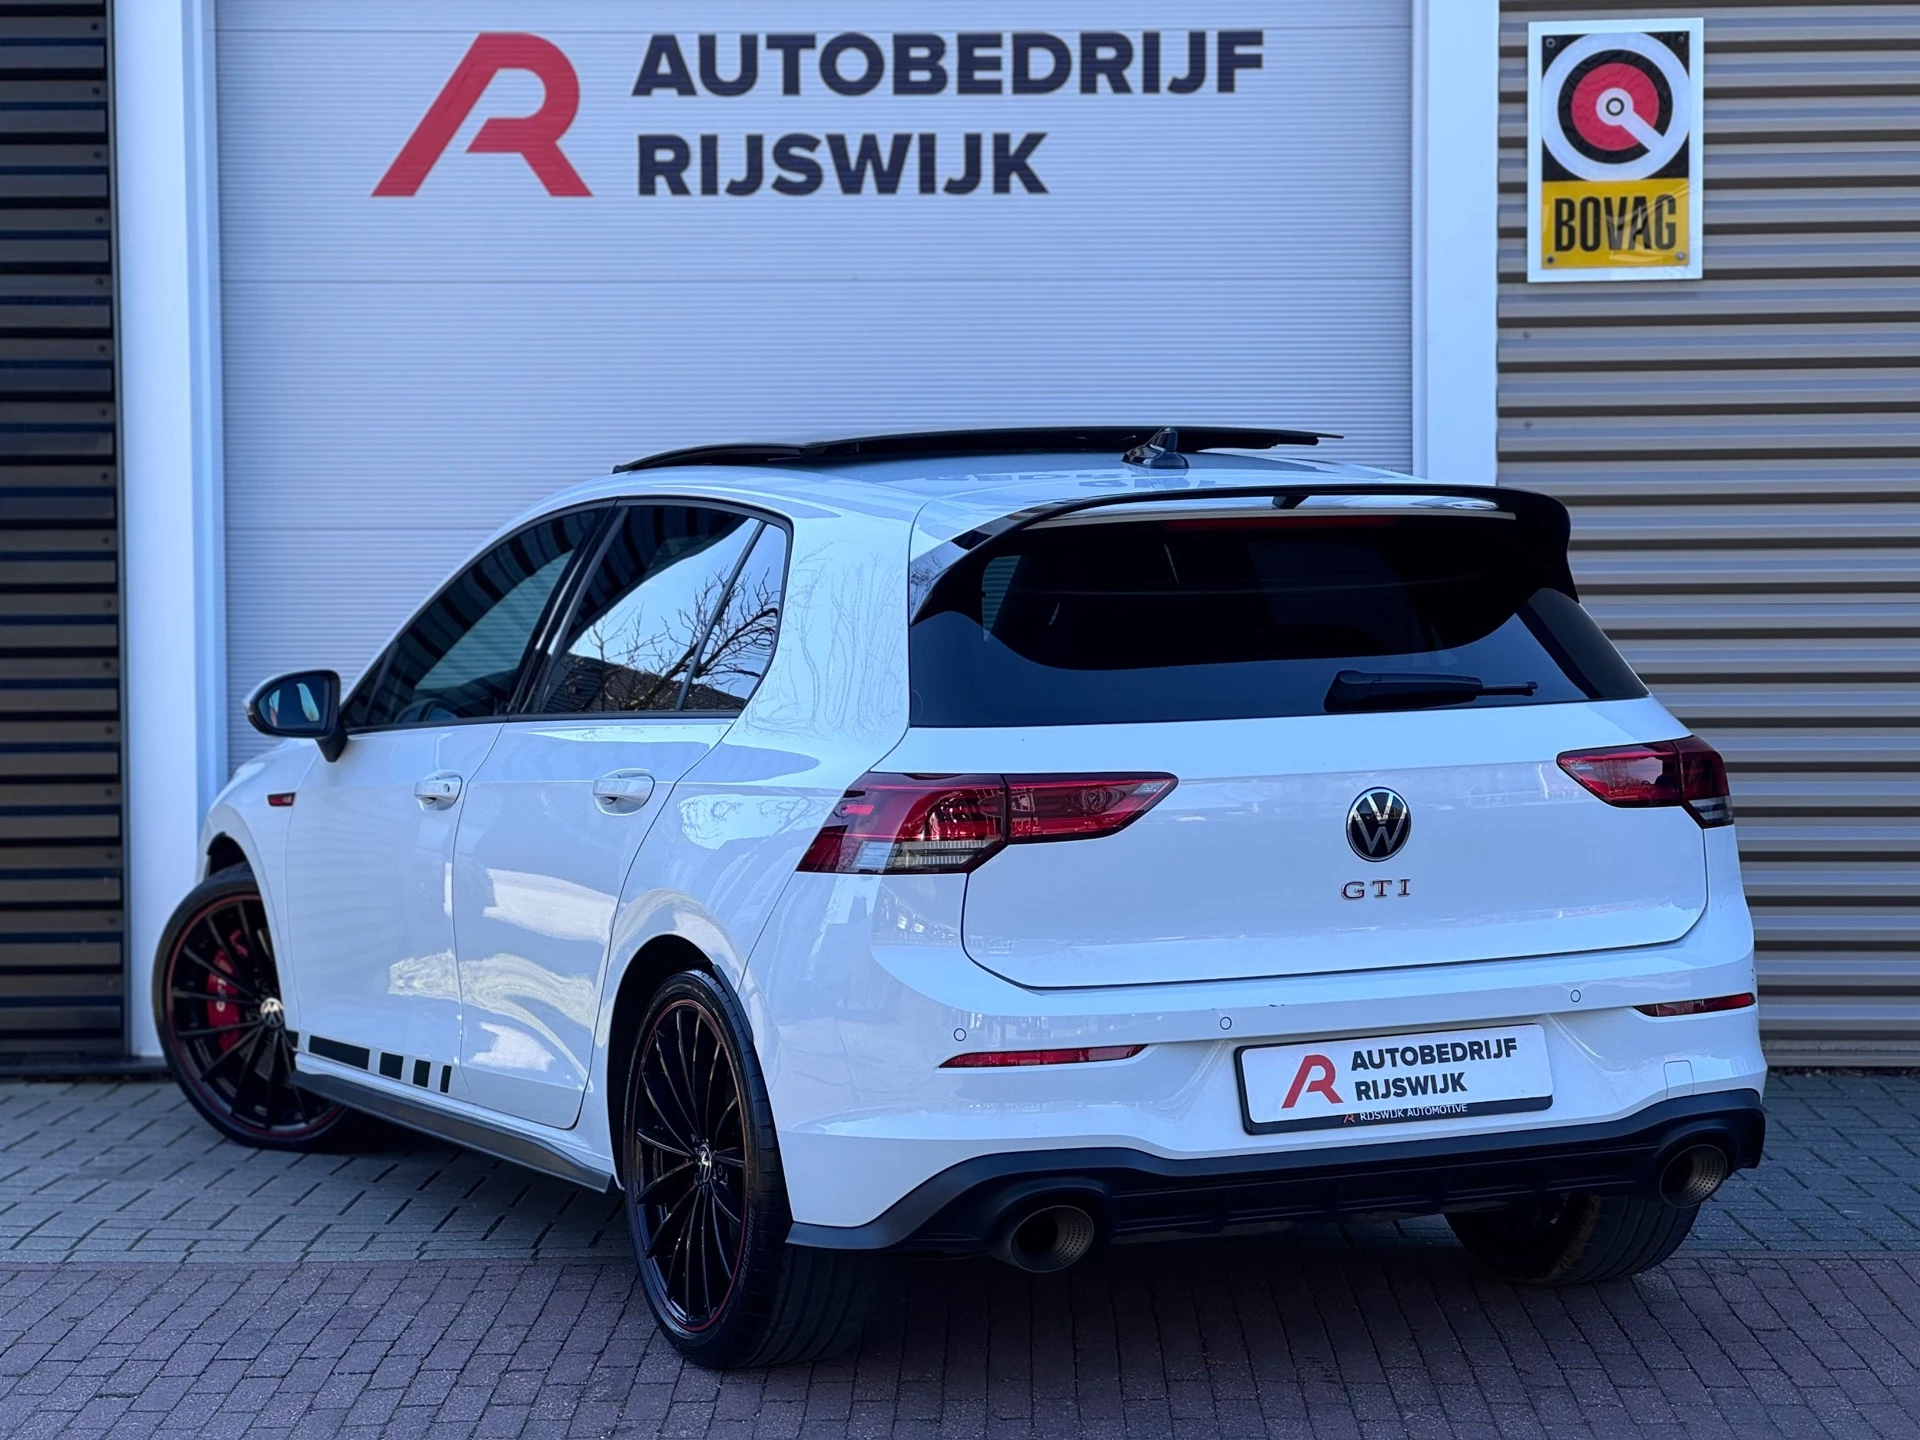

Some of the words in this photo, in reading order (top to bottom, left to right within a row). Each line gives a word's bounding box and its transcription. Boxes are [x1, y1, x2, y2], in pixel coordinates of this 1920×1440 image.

[631, 30, 1264, 97] AUTOBEDRIJF
[637, 132, 1049, 196] RIJSWIJK
[1554, 194, 1677, 252] BOVAG
[1341, 878, 1411, 900] GTI
[1351, 1037, 1518, 1072] AUTOBEDRIJF
[1355, 1072, 1468, 1102] RIJSWIJK
[1360, 1108, 1405, 1121] RIJSWIJK
[1406, 1103, 1468, 1117] AUTOMOTIVE
